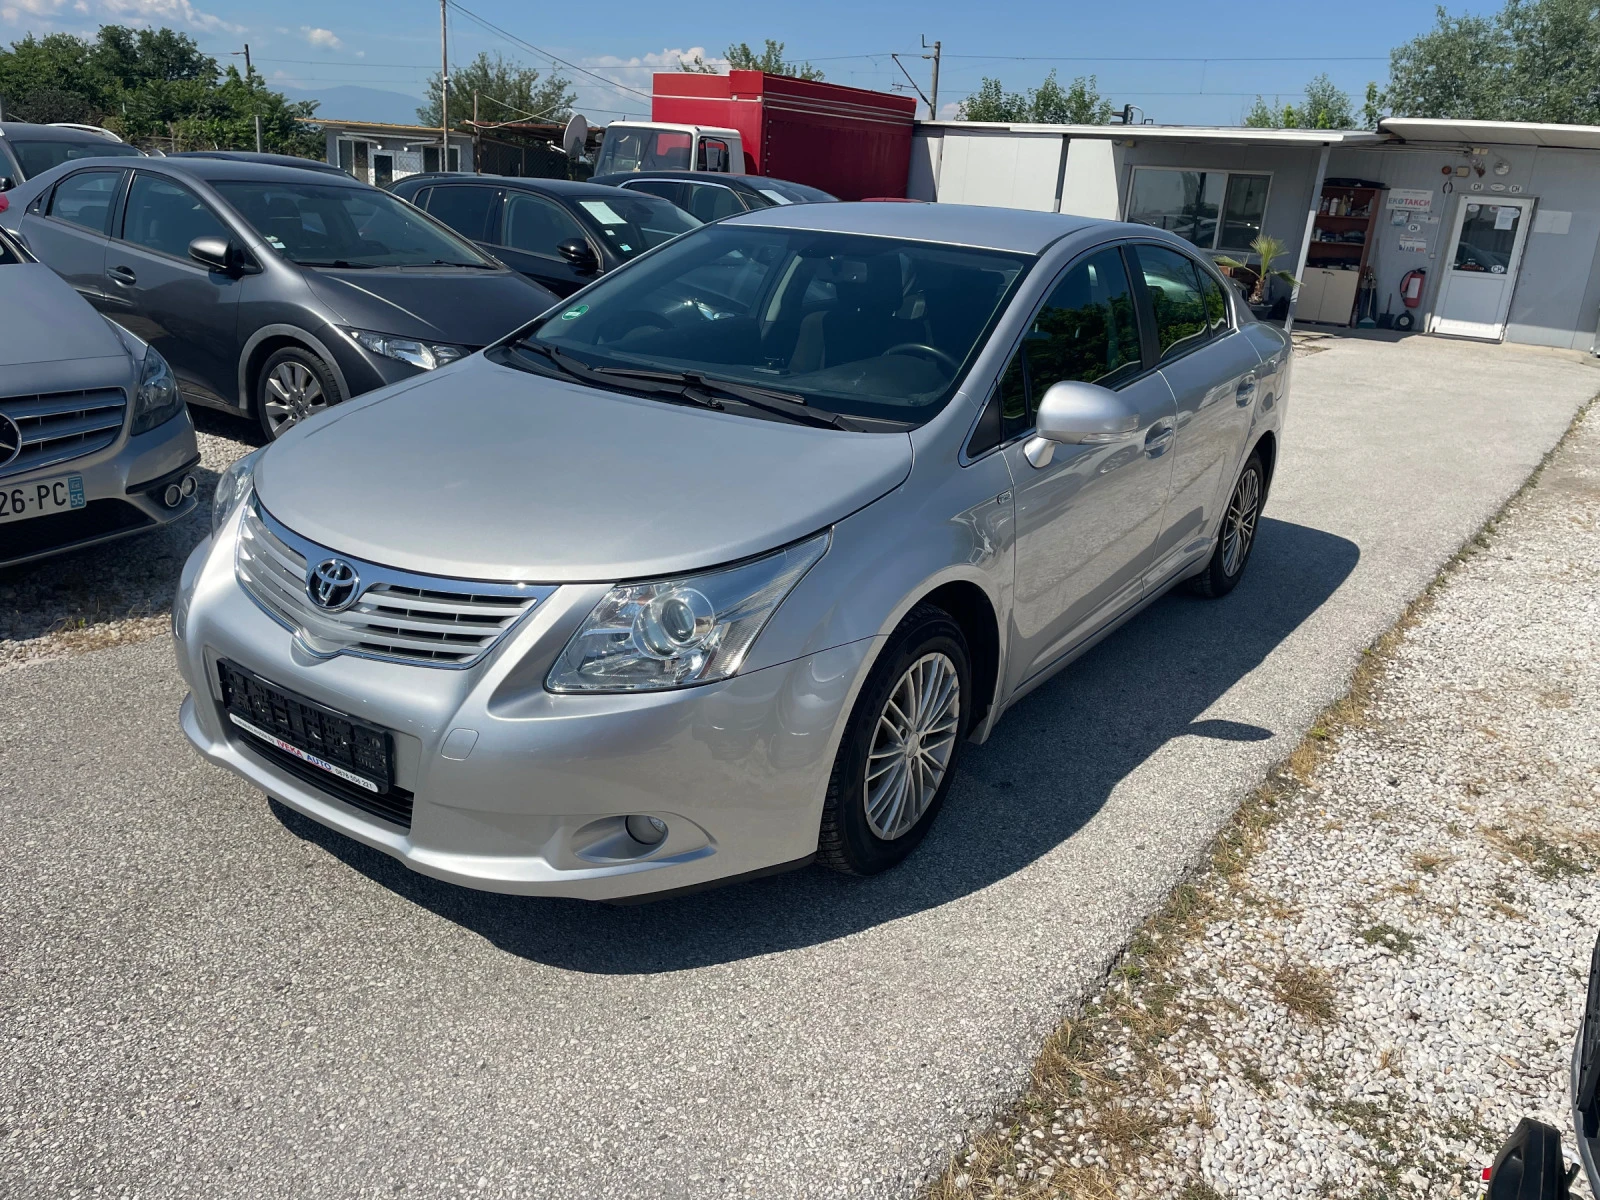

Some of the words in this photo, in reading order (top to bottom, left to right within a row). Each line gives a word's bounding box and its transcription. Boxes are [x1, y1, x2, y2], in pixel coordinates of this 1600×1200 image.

[1388, 198, 1431, 207] ЕКОТАКСИ
[71, 493, 84, 506] 55
[306, 754, 332, 771] AUTO
